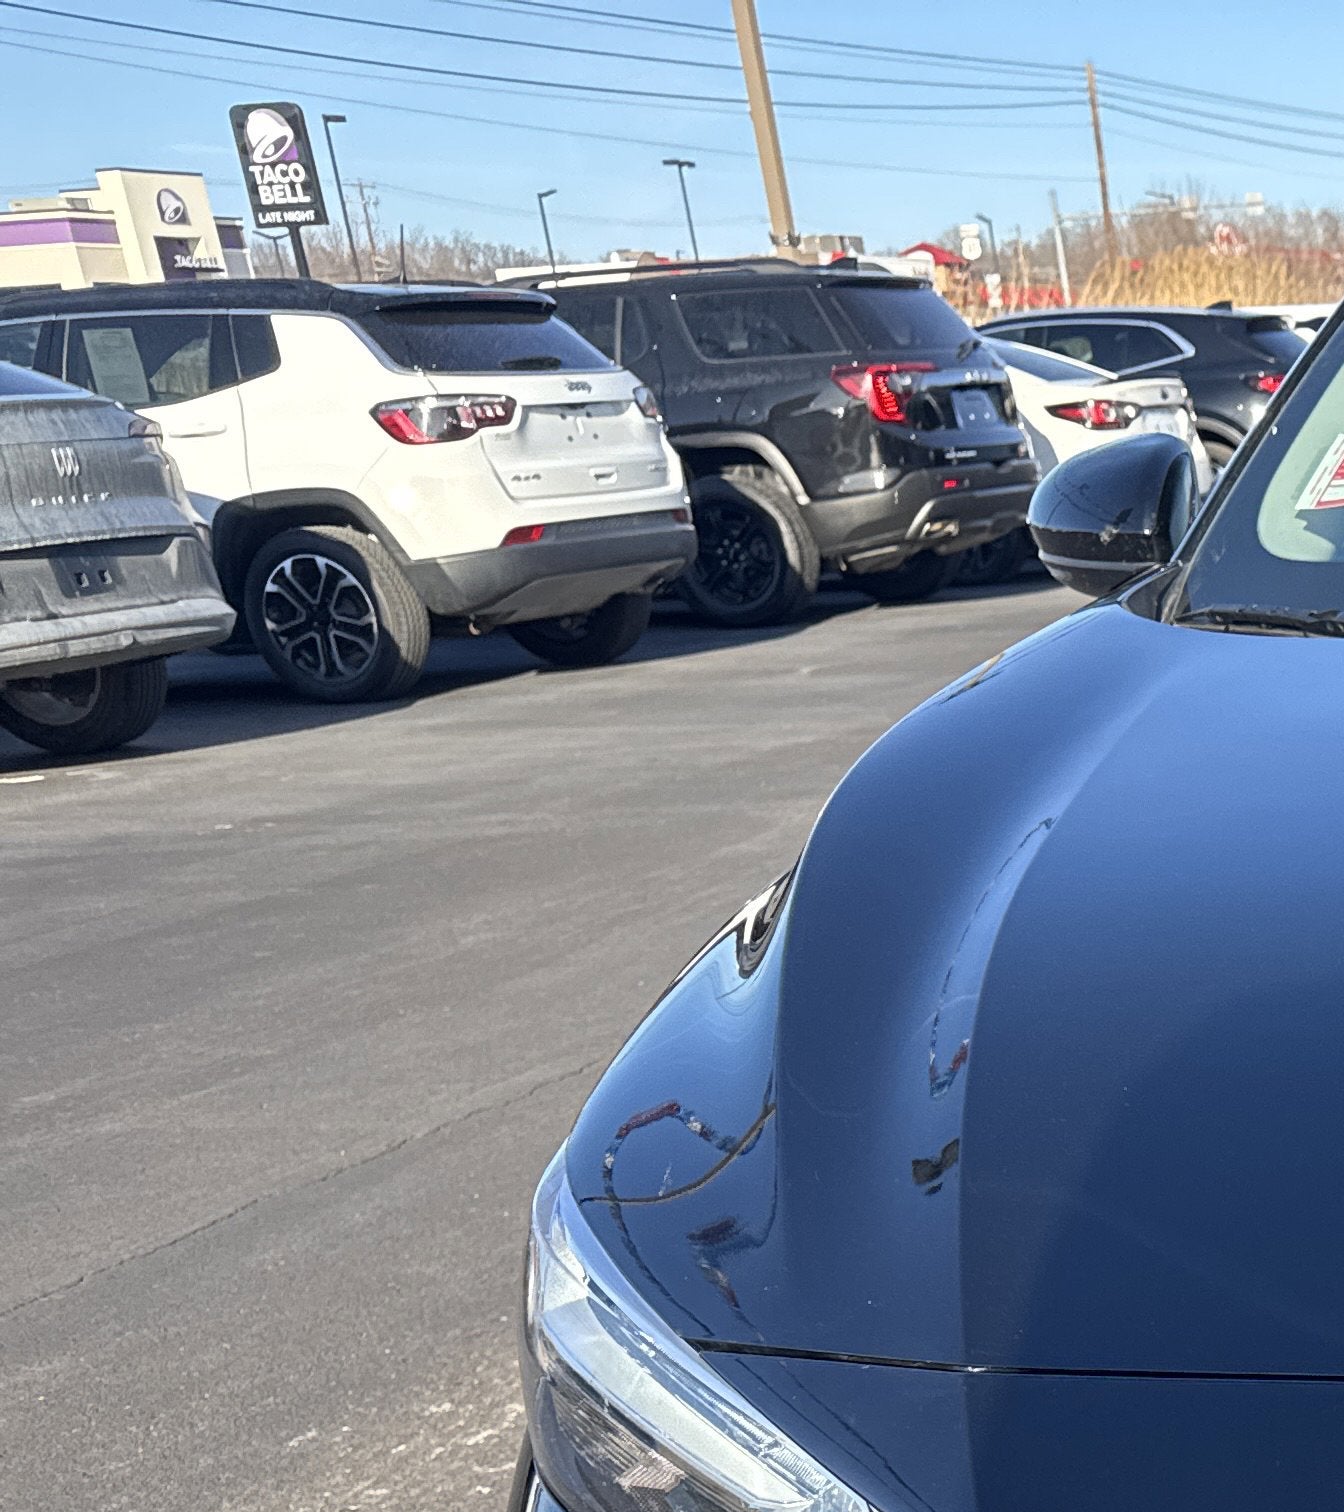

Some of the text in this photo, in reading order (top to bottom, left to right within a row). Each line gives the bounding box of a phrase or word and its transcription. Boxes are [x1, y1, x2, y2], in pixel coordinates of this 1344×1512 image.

[249, 162, 306, 185] TACO
[258, 183, 311, 205] BELL
[258, 209, 315, 224] LATE NIGHT
